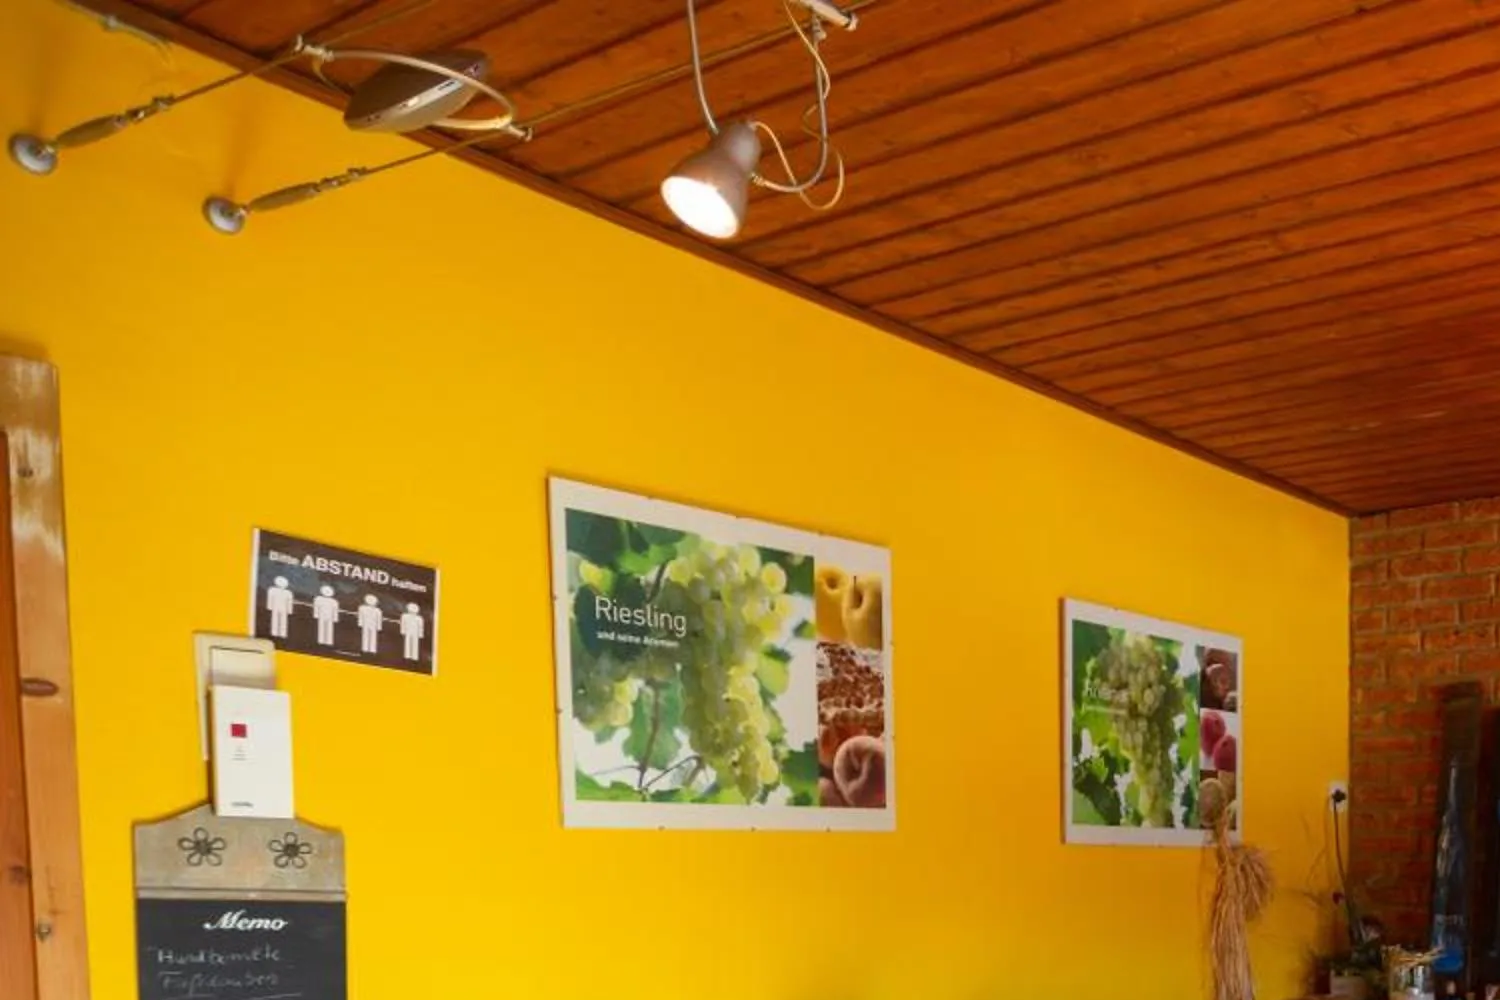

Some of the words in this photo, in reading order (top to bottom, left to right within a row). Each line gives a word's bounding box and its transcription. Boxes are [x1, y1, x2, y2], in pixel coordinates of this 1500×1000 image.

[268, 550, 299, 565] Bitte
[301, 554, 390, 585] ABSTAND
[391, 578, 427, 593] halten
[595, 595, 687, 637] Riesling
[203, 909, 288, 931] Memo
